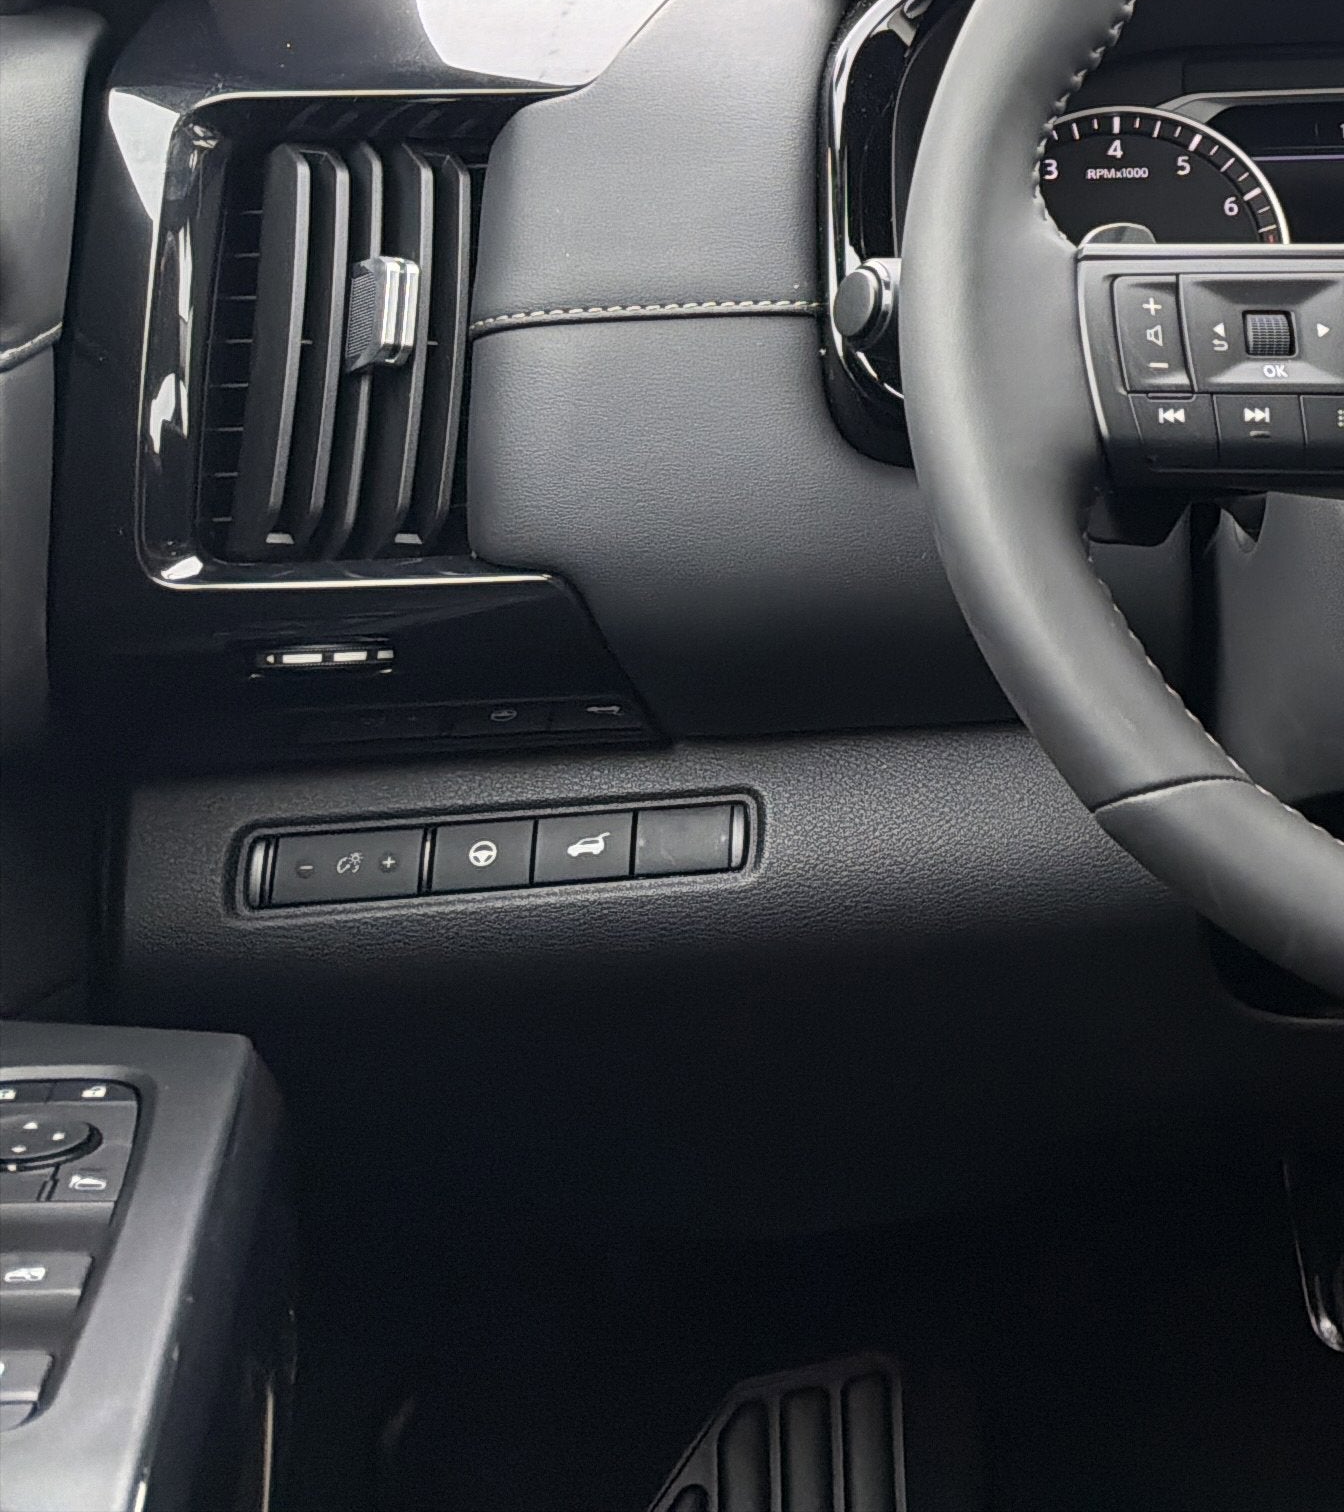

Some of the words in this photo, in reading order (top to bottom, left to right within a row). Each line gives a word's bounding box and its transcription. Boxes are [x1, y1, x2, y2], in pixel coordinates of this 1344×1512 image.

[1106, 139, 1124, 159] 4
[1042, 159, 1058, 180] 3
[1176, 156, 1191, 176] 5
[1223, 197, 1239, 216] 6
[1263, 365, 1289, 378] OK
